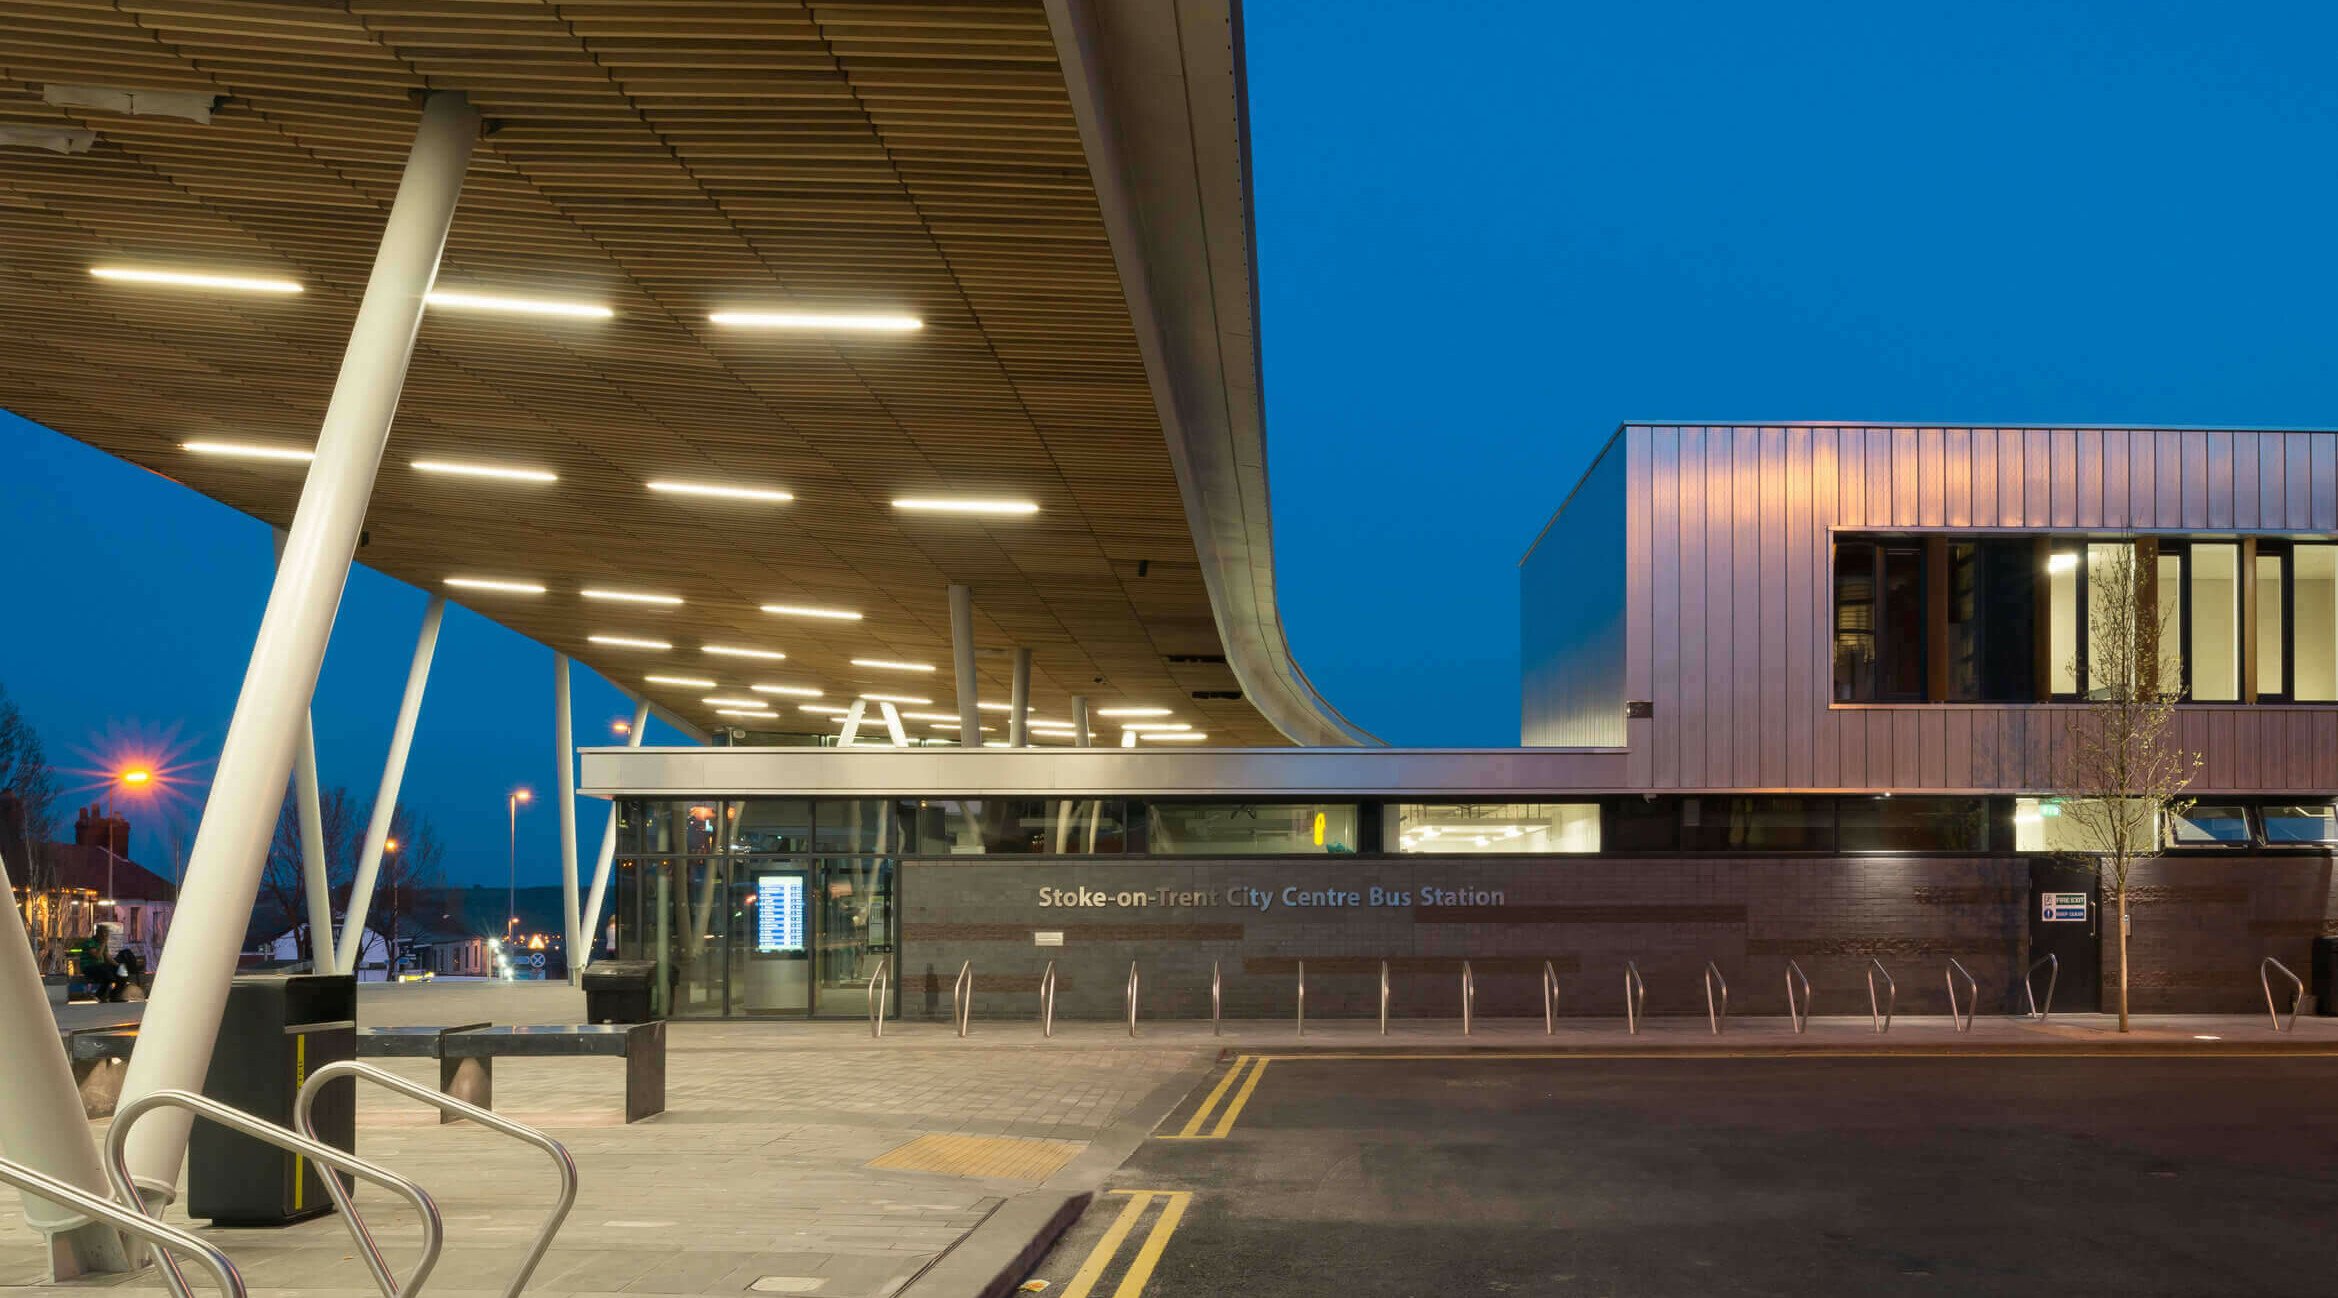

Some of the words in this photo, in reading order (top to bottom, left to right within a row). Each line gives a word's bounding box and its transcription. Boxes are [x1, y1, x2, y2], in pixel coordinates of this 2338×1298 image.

[1039, 886, 1217, 907] Stoke-on-Trent
[1227, 886, 1275, 911] City
[1282, 886, 1361, 907] Centre
[1369, 886, 1412, 907] Bus
[1420, 886, 1505, 907] Station
